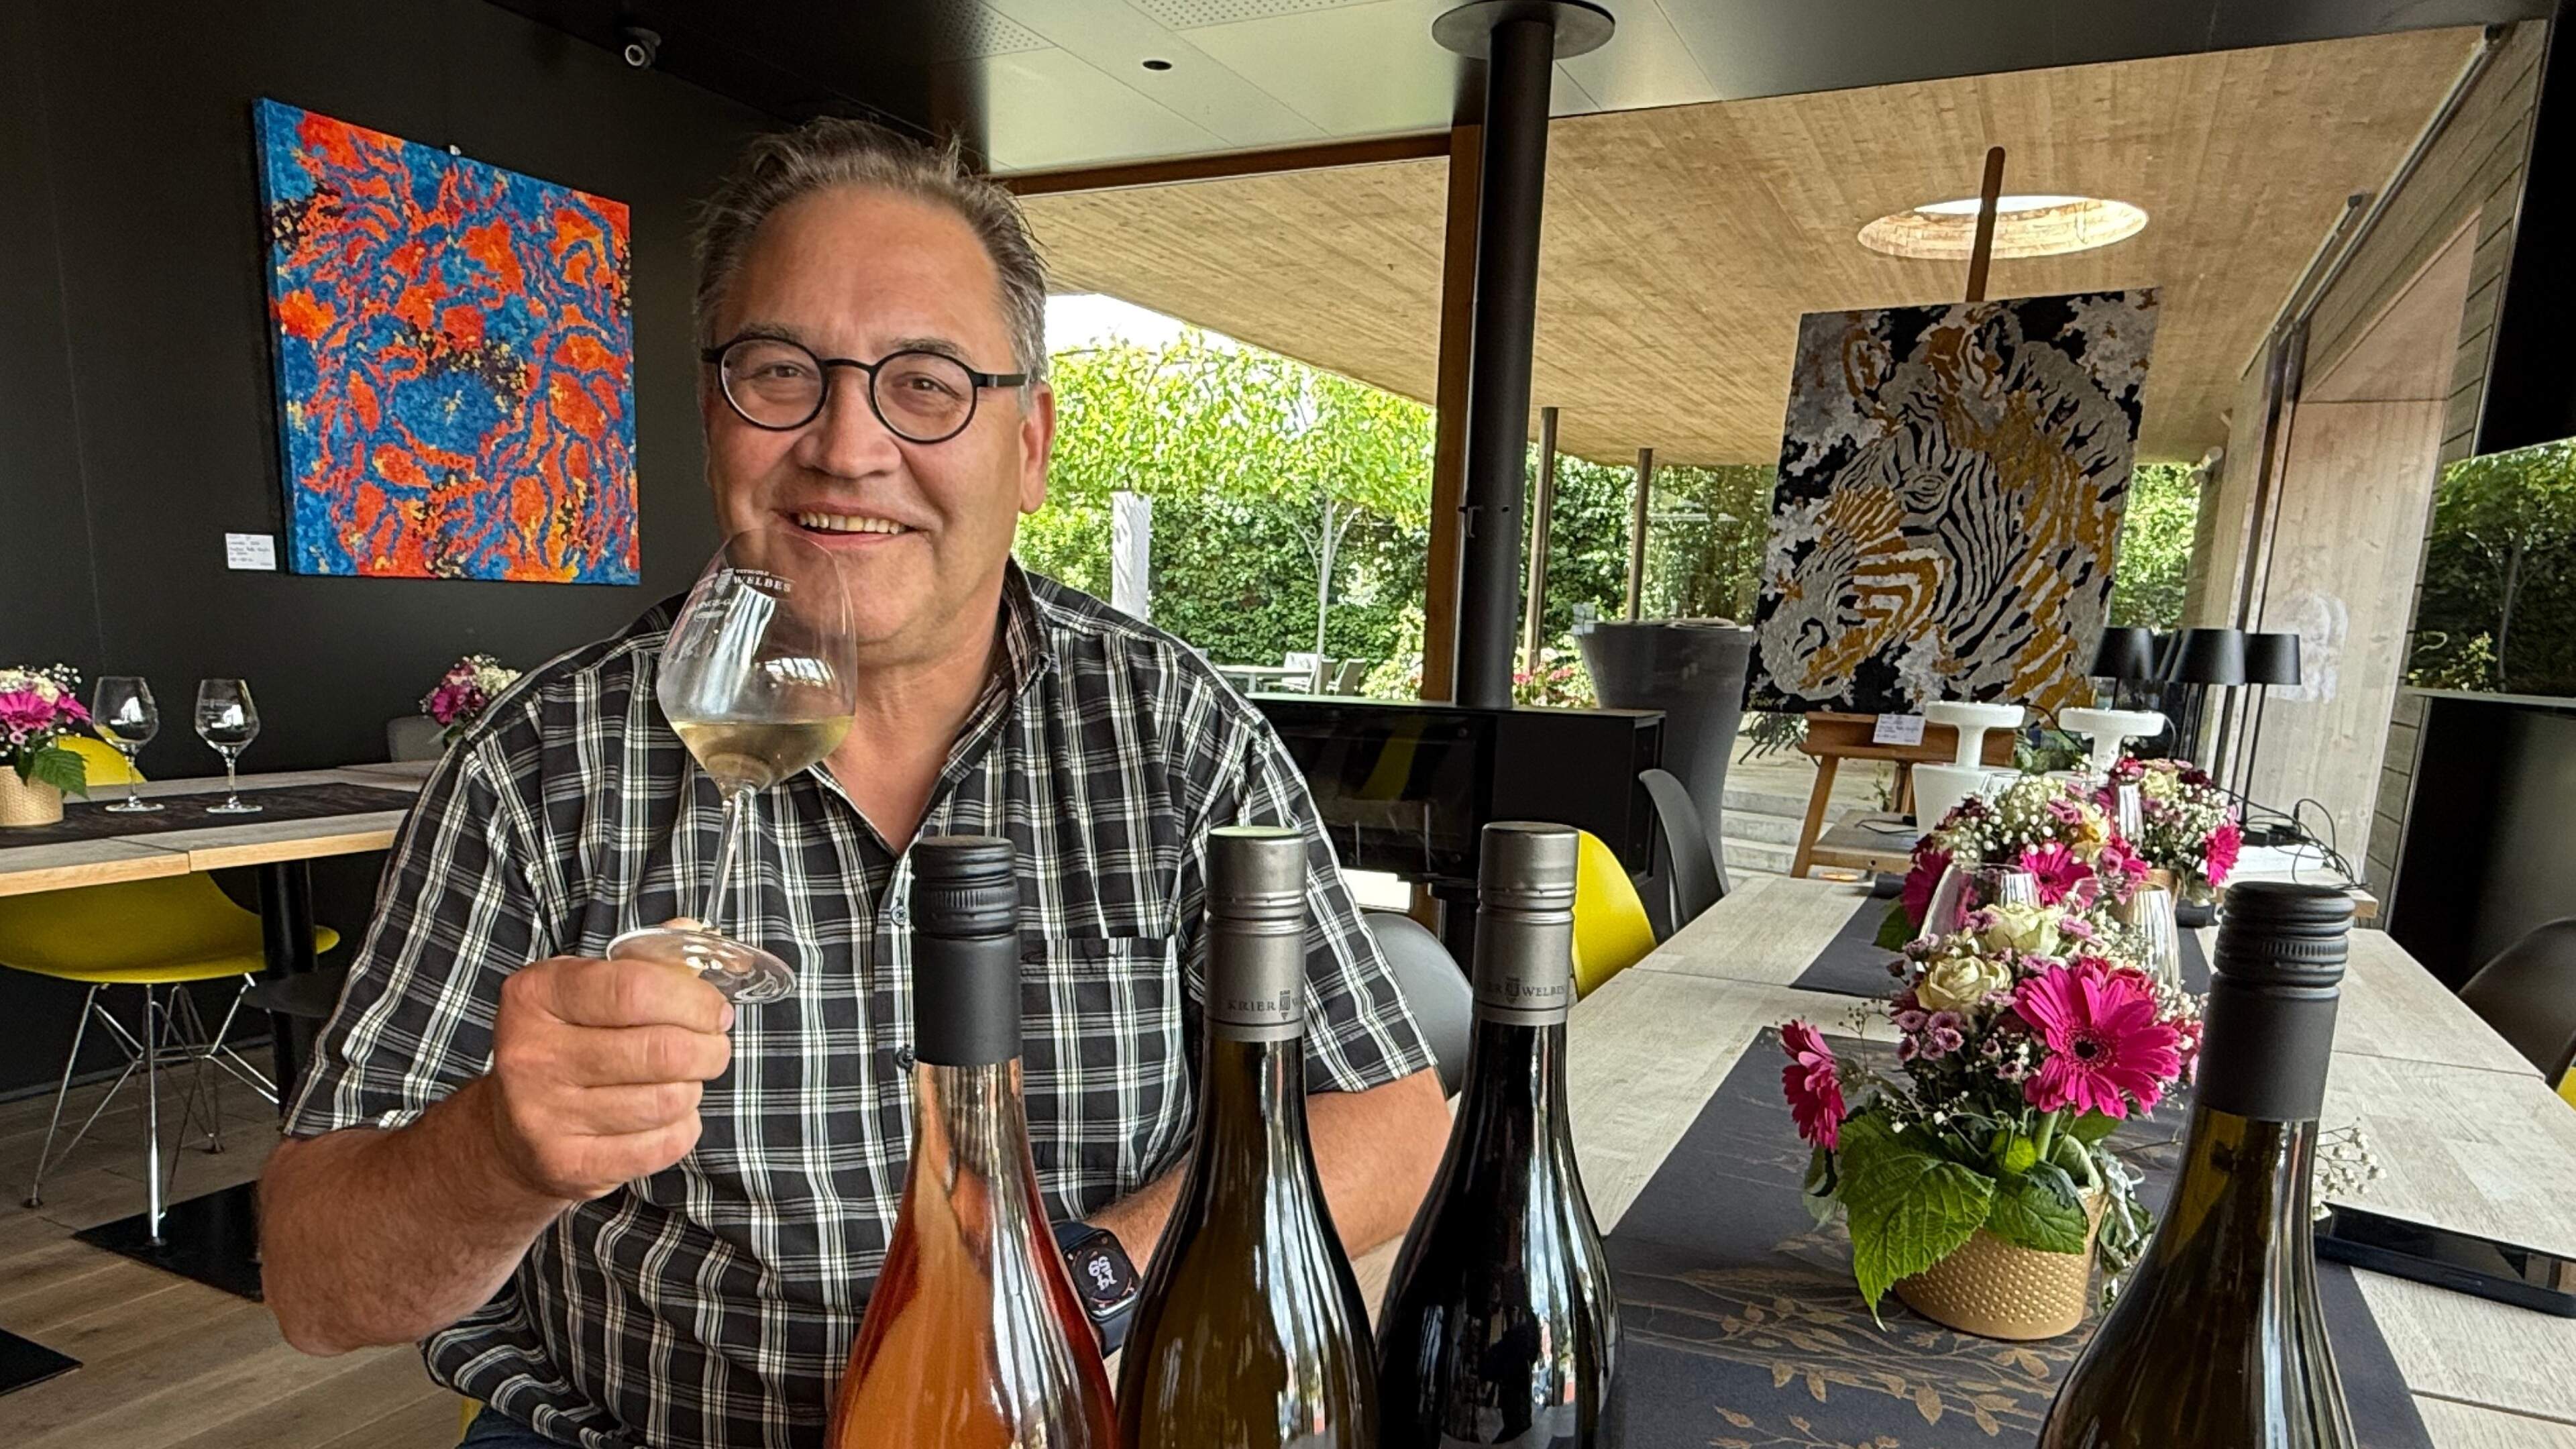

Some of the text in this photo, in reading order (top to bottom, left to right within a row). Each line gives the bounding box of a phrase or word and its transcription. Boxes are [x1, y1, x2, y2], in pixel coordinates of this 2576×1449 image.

[734, 576, 792, 592] WELBES
[1227, 1000, 1277, 1012] KRIER
[1087, 1256, 1111, 1277] 59
[1097, 1269, 1118, 1291] 14
